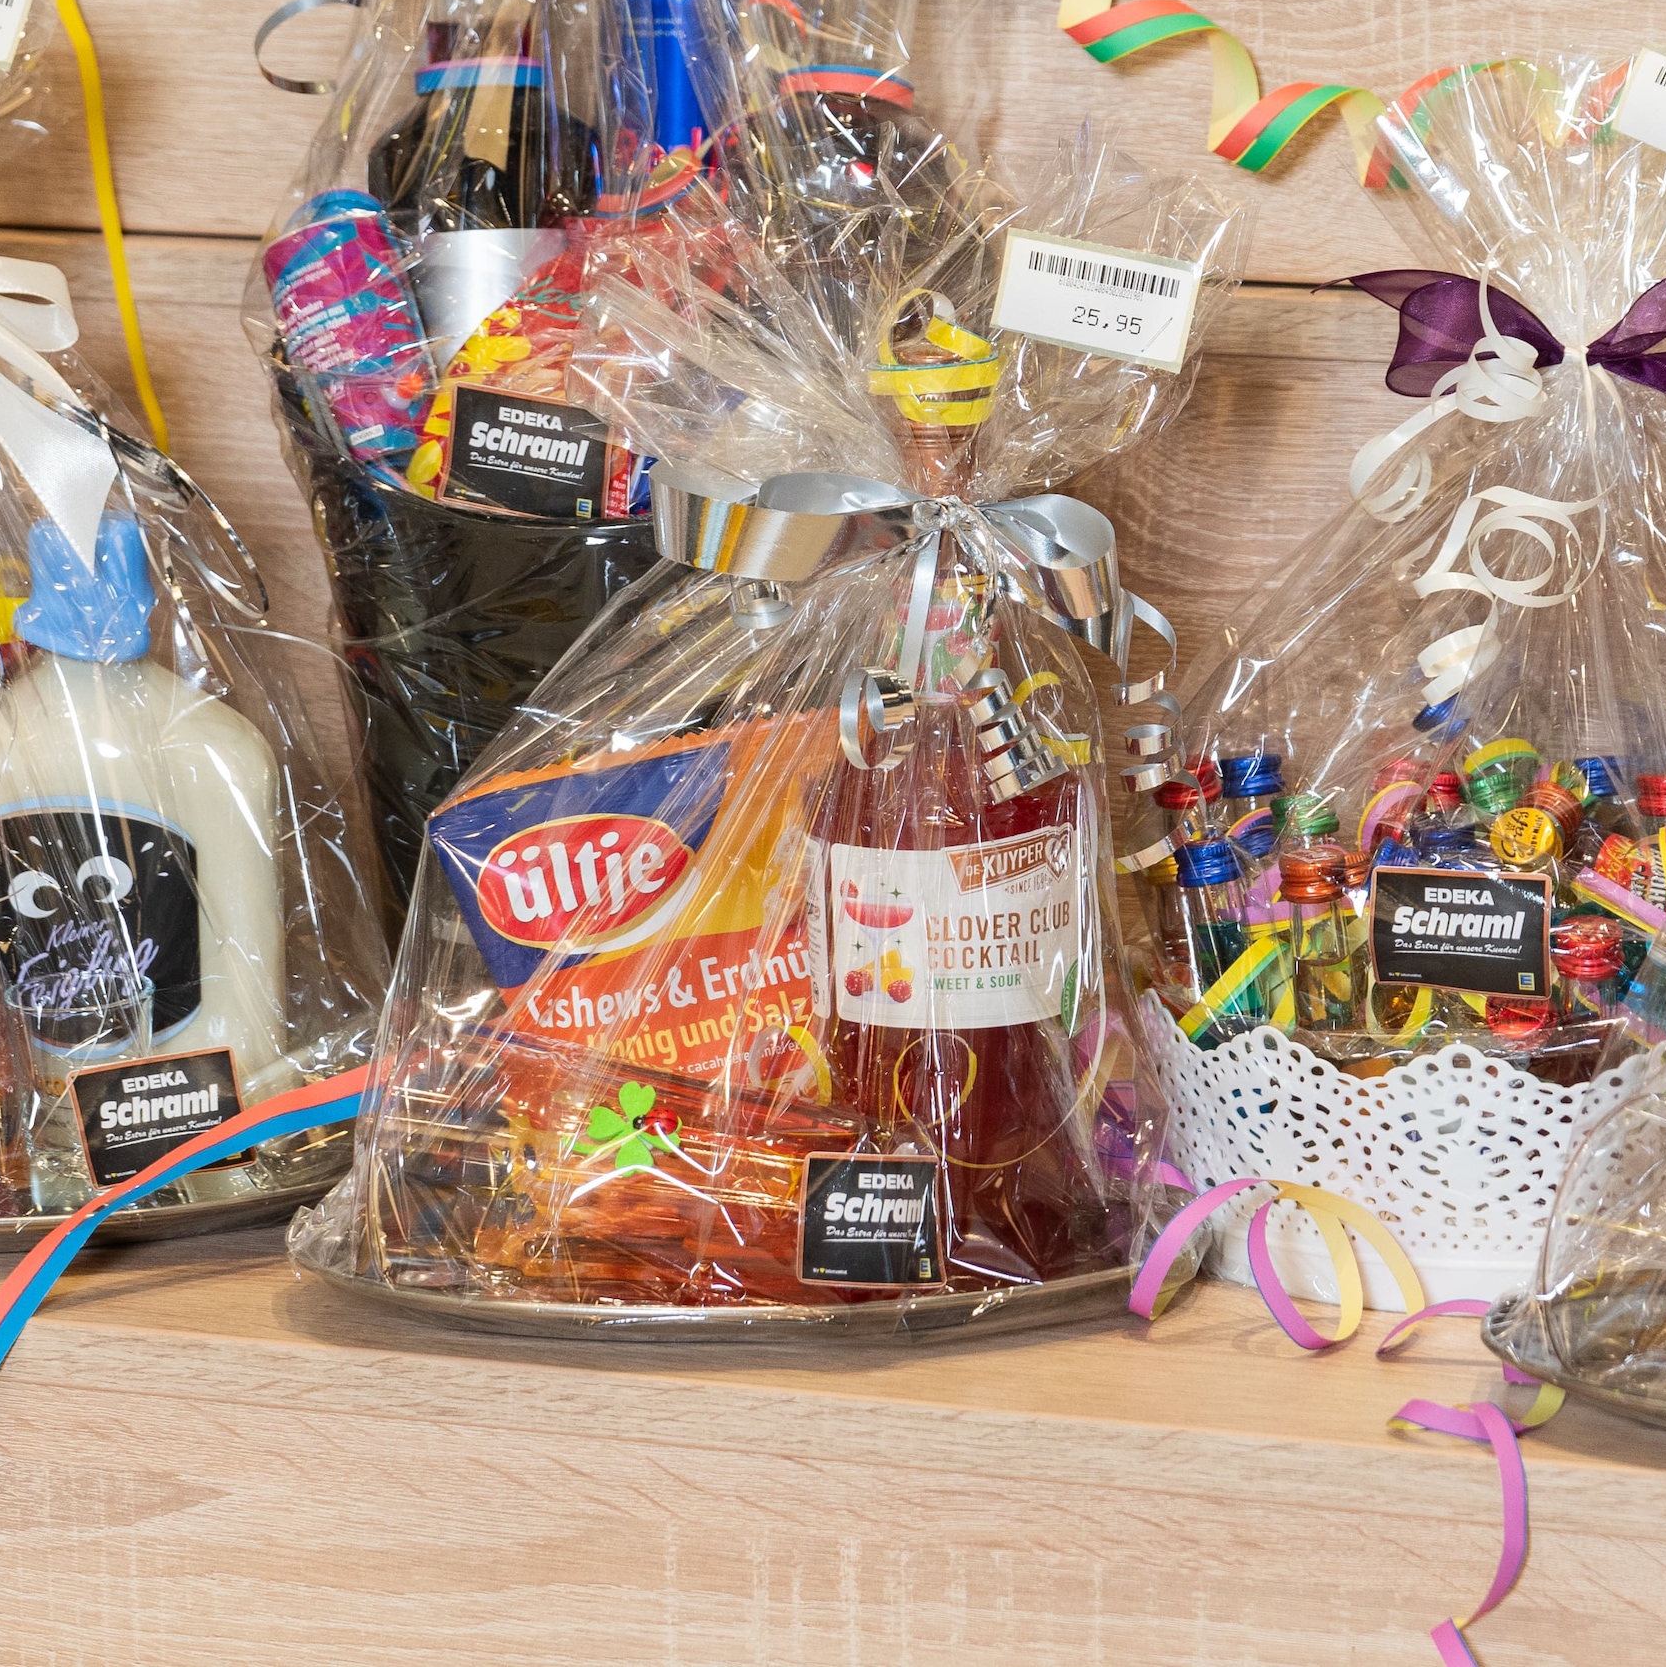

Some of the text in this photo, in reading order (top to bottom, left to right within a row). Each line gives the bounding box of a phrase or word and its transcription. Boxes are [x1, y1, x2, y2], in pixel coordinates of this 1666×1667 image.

[1072, 306, 1143, 336] 25,95
[498, 406, 563, 431] EDEKA
[469, 421, 590, 467] Schraml
[469, 451, 486, 463] Das
[487, 455, 509, 468] Extra
[549, 467, 585, 480] Kunden!
[983, 843, 1044, 877] KUYPER
[497, 831, 668, 924] ültje
[1424, 887, 1495, 906] EDEKA
[927, 900, 1070, 943] CLOVER CLUB
[1392, 905, 1526, 941] Schraml
[927, 939, 1041, 970] COCKTAIL
[1394, 939, 1523, 955] Das Extra für unsere Kunden!
[667, 966, 698, 1009] &
[927, 977, 969, 991] WEET
[990, 974, 1022, 989] SOUR
[679, 1017, 738, 1051] und
[744, 991, 809, 1029] Salz
[121, 1070, 189, 1093] EDEKA
[100, 1084, 219, 1130] Schraml
[106, 1132, 124, 1143] Das
[124, 1128, 148, 1140] Extra
[162, 1123, 188, 1134] unsere
[188, 1115, 223, 1130] Kunden!
[859, 1173, 914, 1189] EDEKA
[824, 1192, 925, 1223] Schram
[826, 1226, 845, 1236] Das
[847, 1227, 872, 1237] Extra
